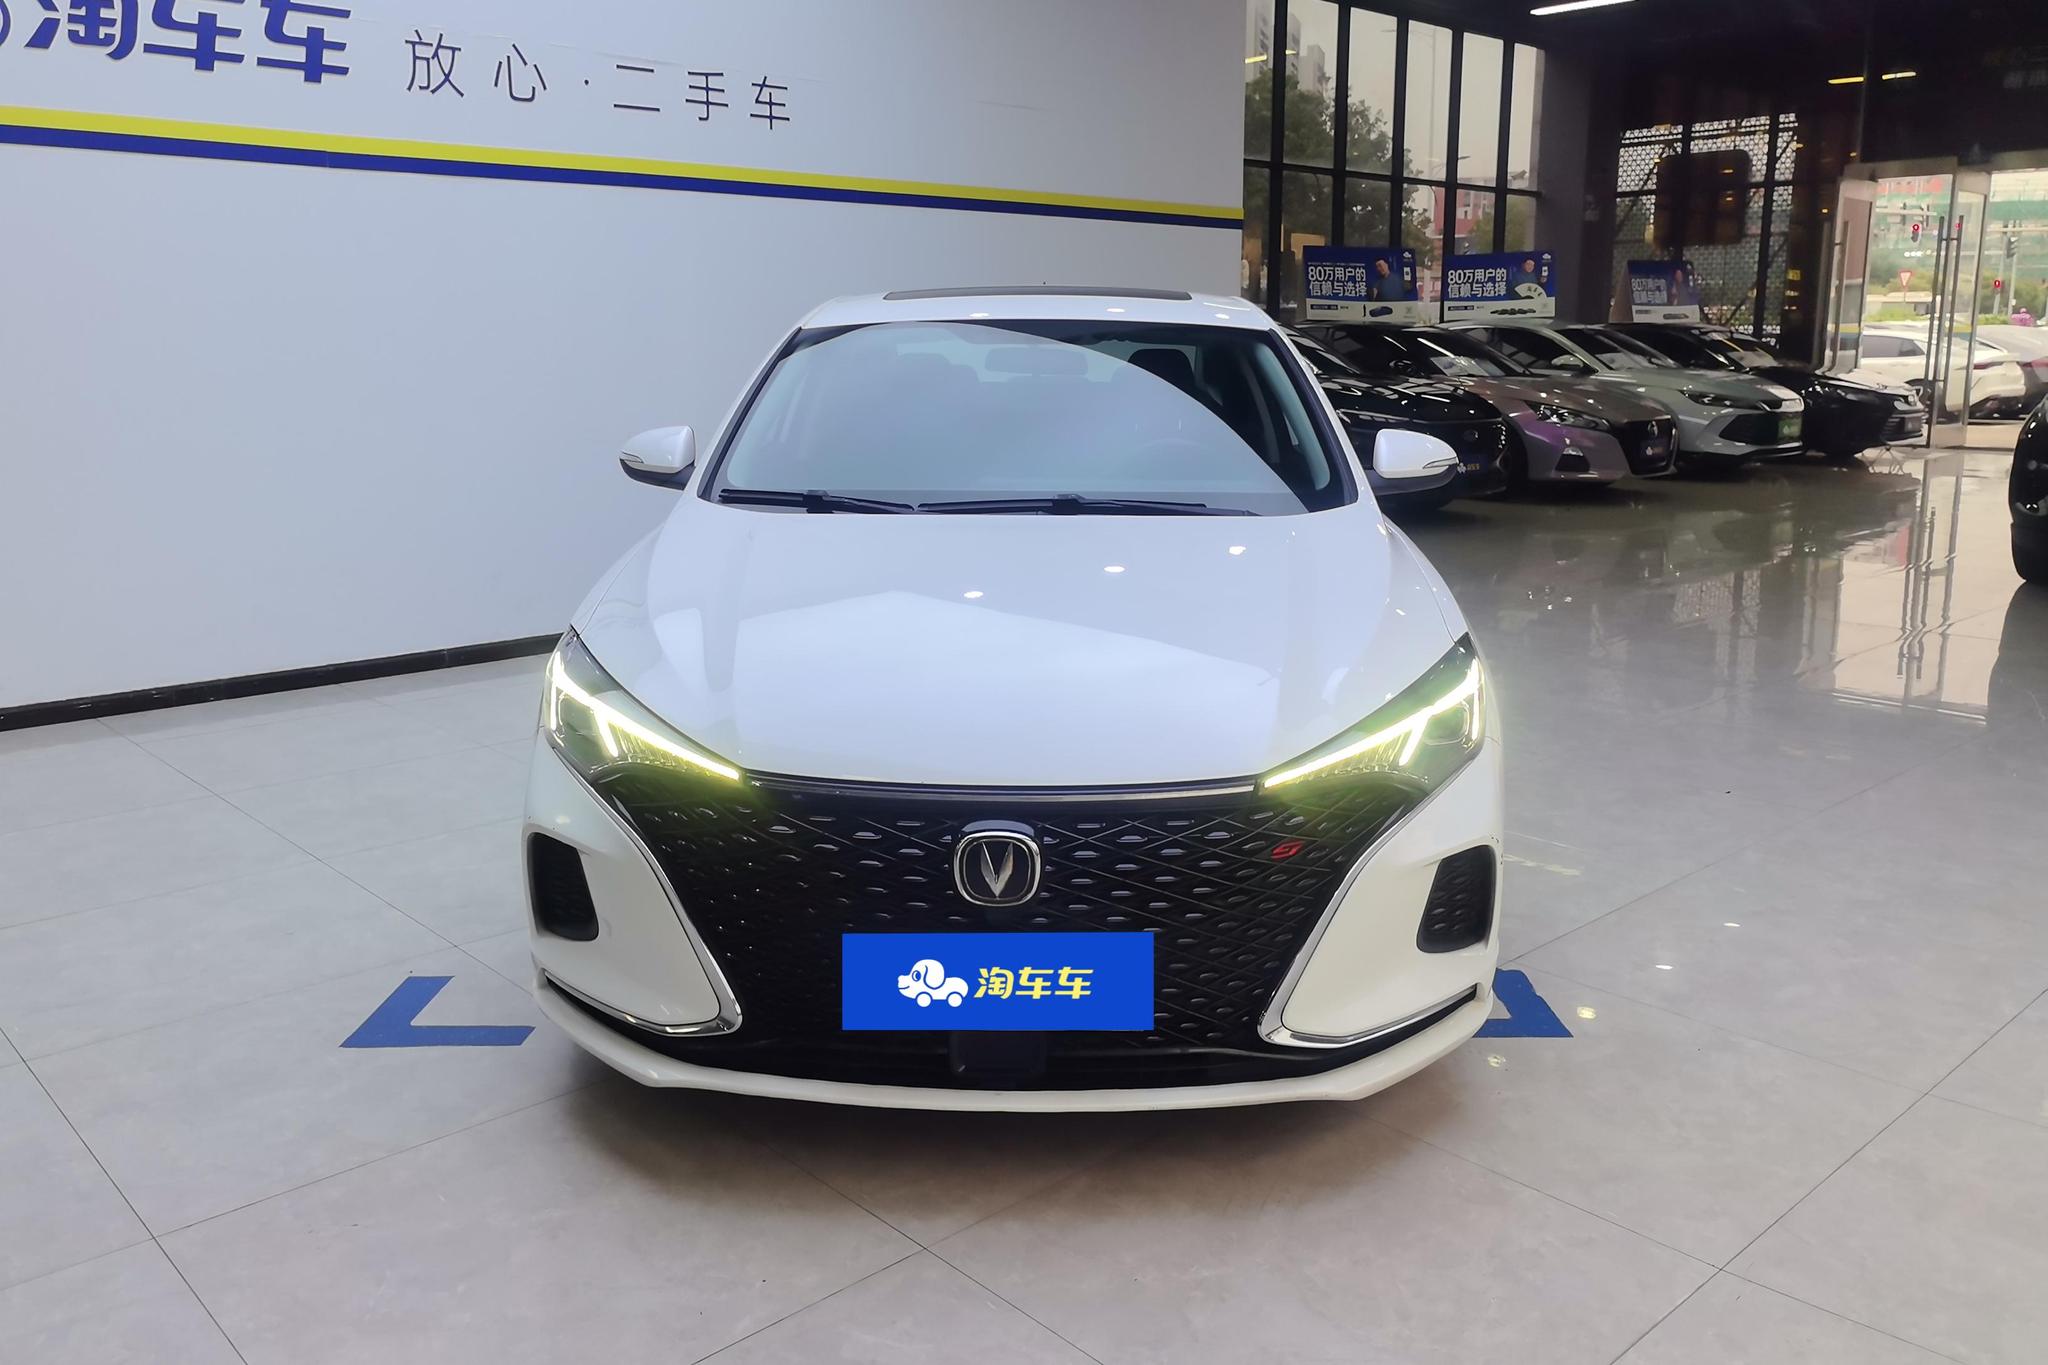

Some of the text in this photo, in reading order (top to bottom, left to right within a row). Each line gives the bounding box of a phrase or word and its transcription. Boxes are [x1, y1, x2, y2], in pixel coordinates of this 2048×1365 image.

[1308, 266, 1366, 281] 80万用户的
[1447, 268, 1507, 284] 80万用户的
[1309, 281, 1368, 297] 信赖与选择
[1447, 282, 1507, 298] 信赖与选择
